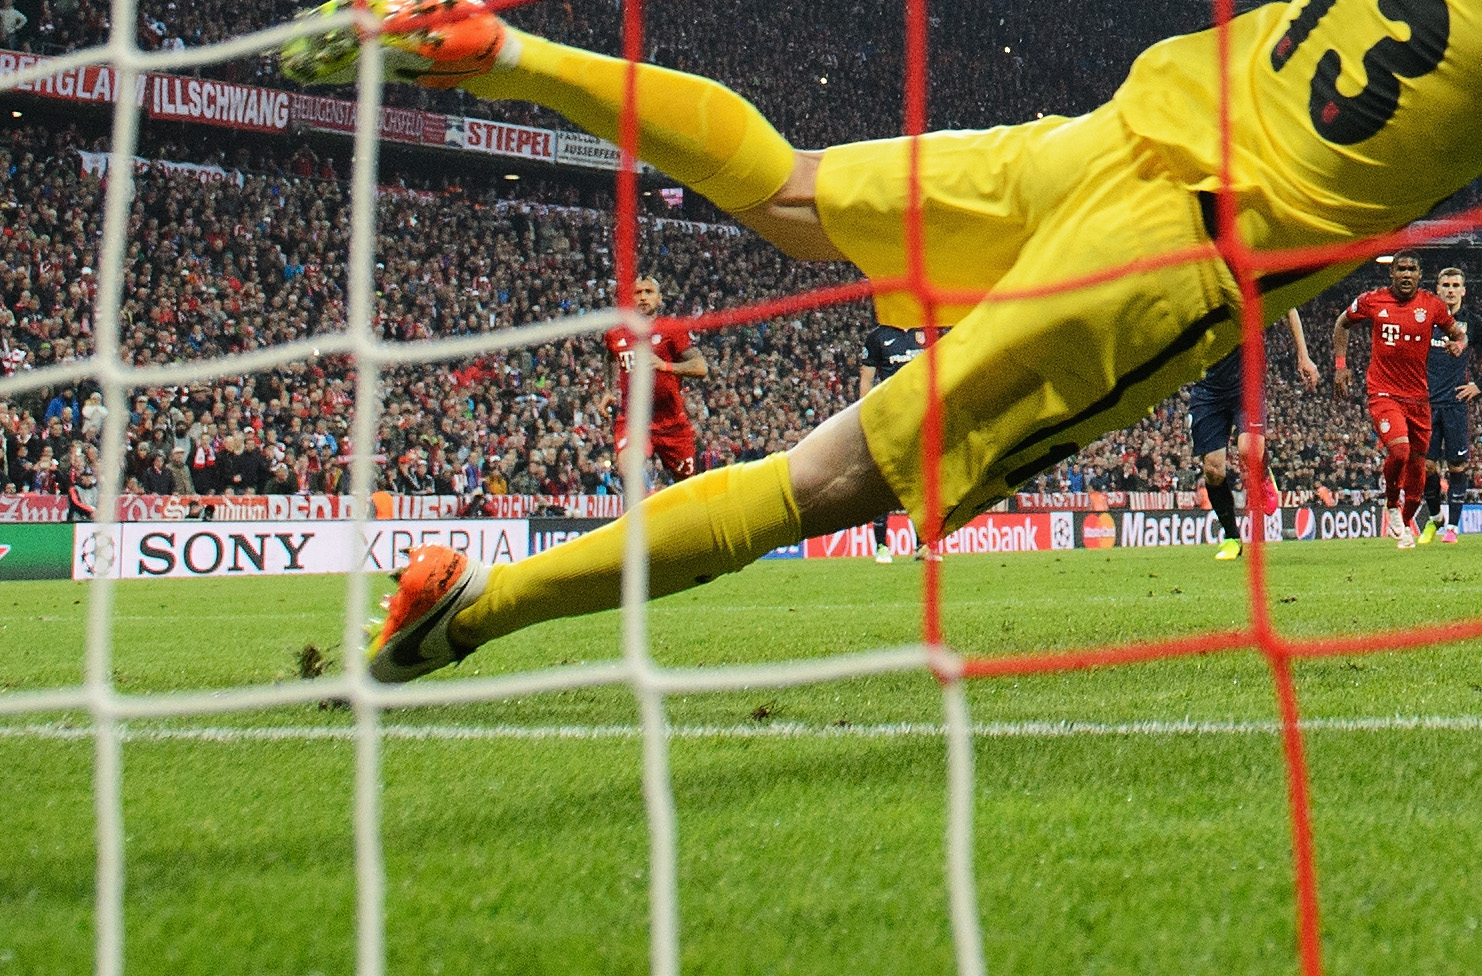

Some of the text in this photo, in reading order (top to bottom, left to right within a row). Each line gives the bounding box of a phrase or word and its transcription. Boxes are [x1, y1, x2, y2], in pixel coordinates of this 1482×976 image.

[153, 76, 289, 129] ILLSCHWANG
[468, 122, 553, 158] STIEPEL
[1321, 506, 1378, 540] pepsi
[138, 531, 315, 575] SONY
